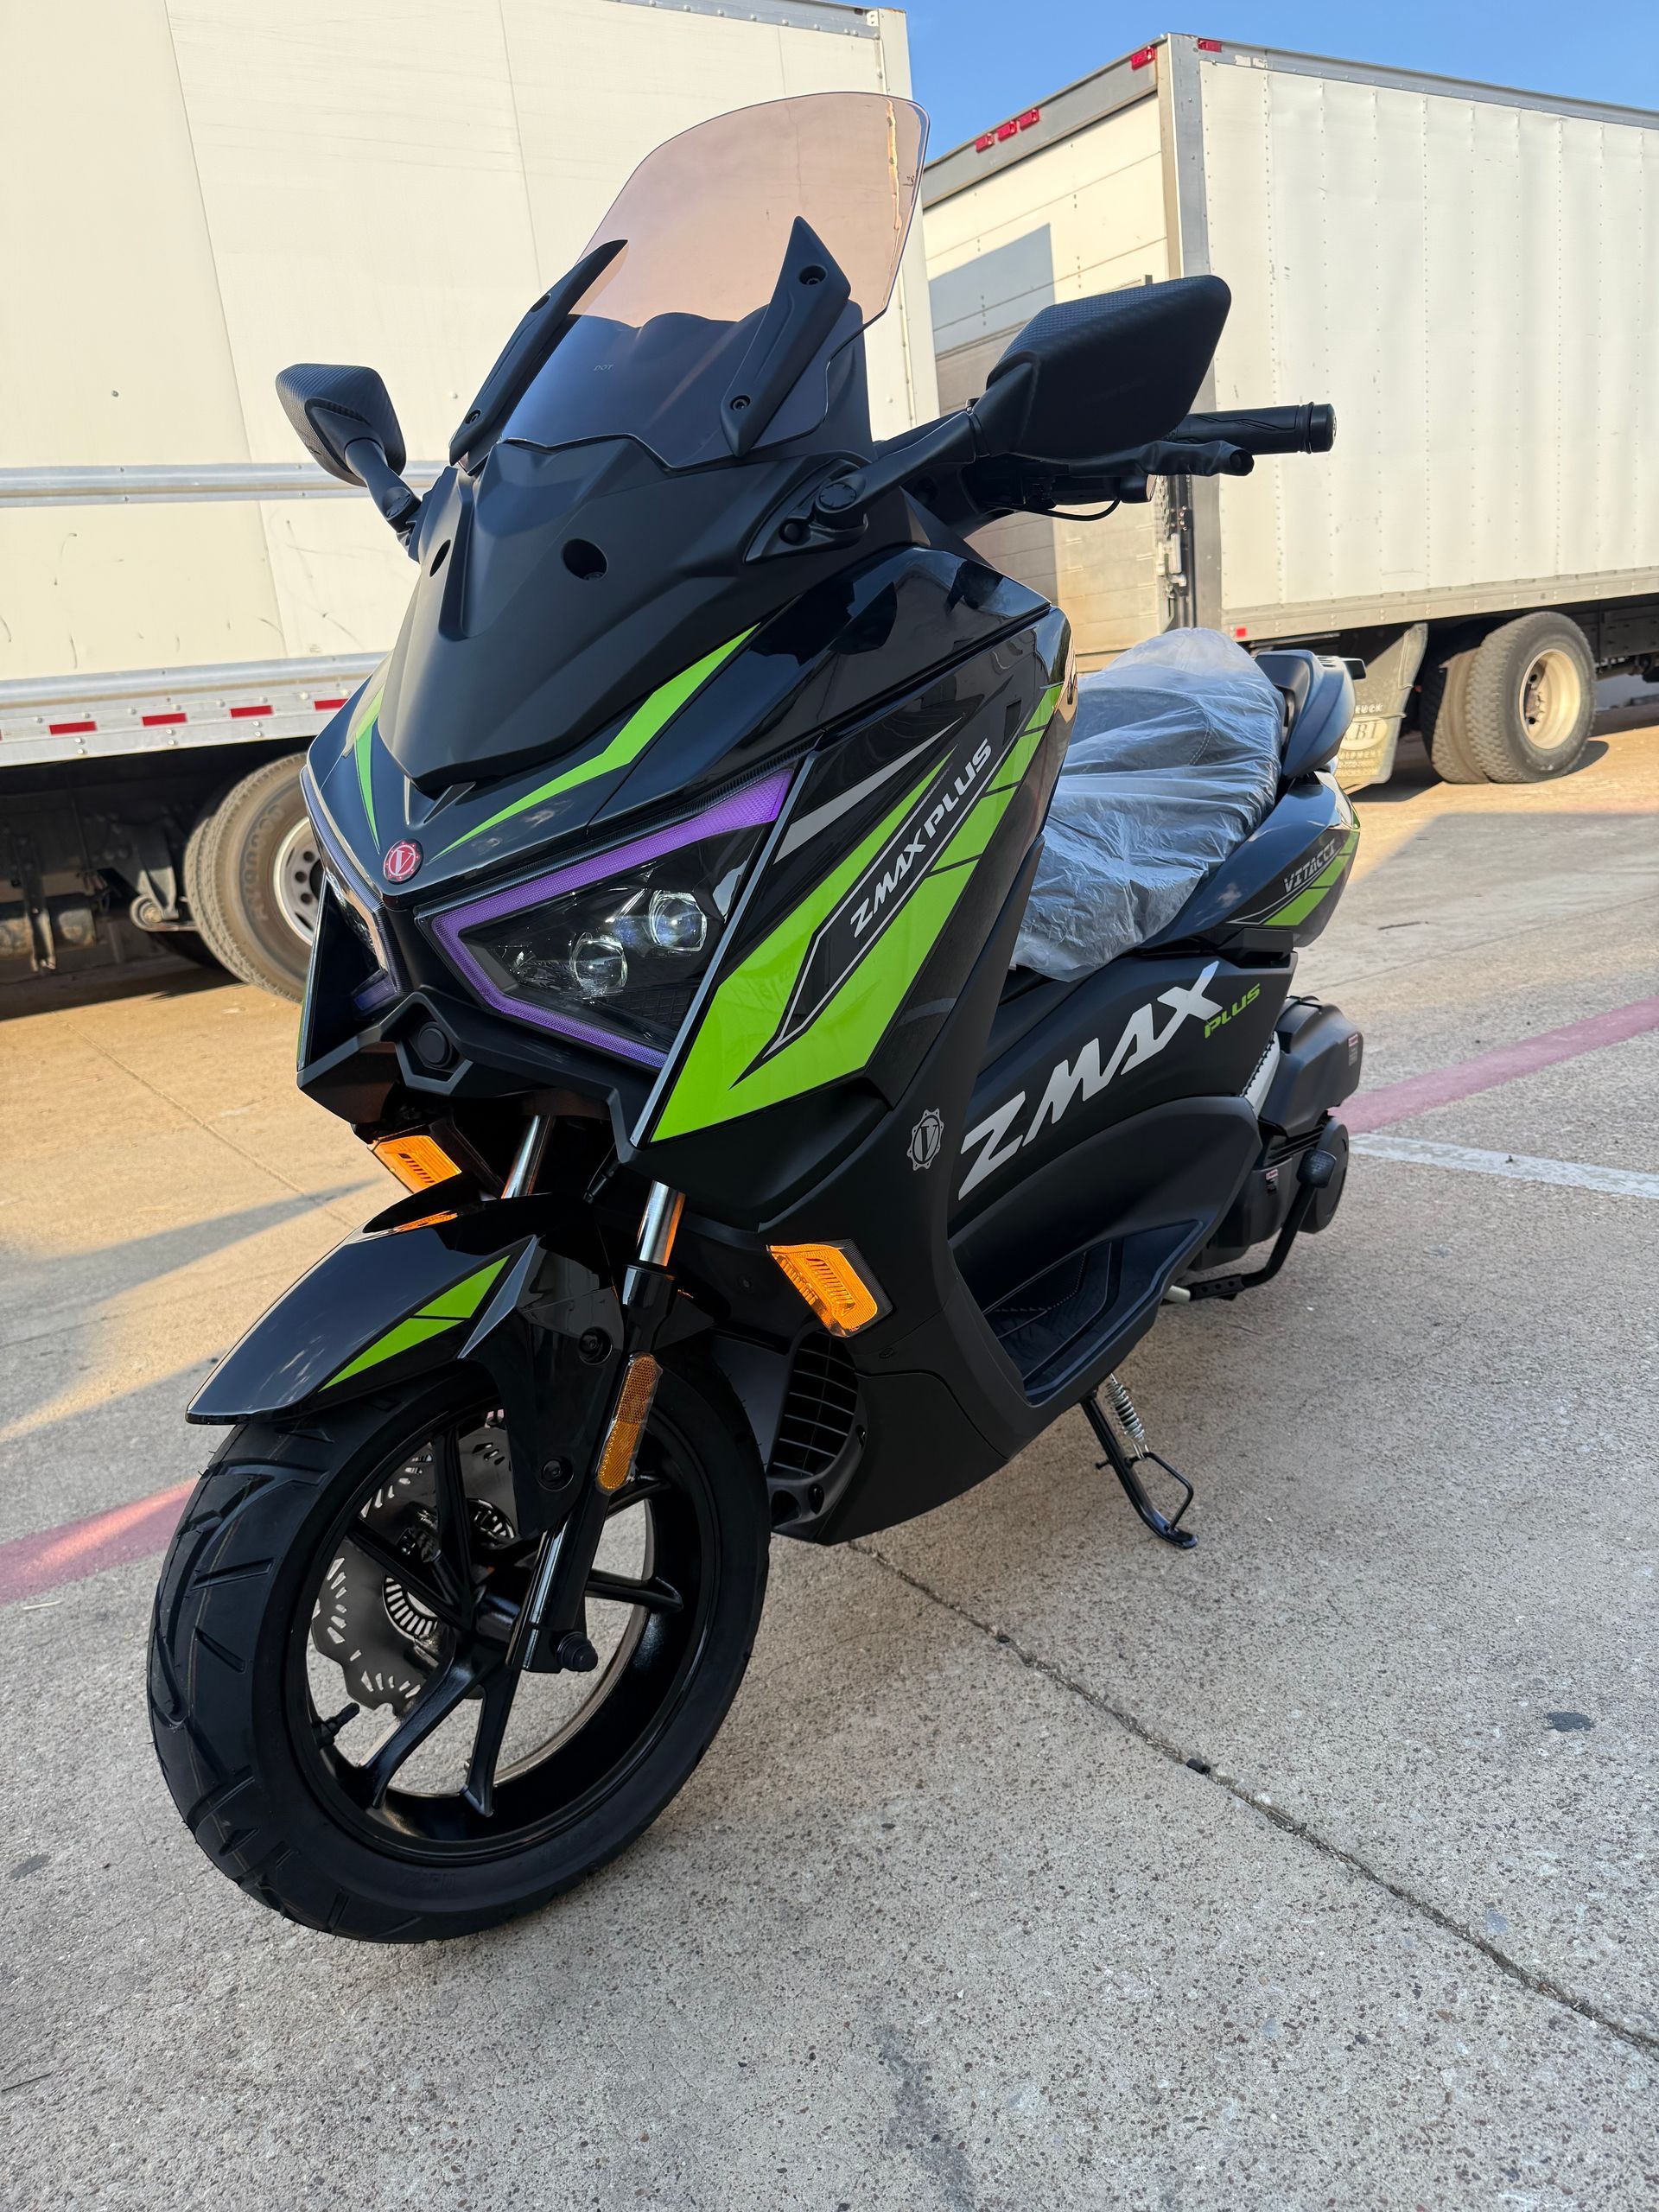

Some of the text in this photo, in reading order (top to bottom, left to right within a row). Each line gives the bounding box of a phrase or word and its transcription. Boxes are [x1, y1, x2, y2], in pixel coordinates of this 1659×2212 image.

[1355, 703, 1382, 714] RUCK
[850, 738, 992, 938] ZMAX PLUS
[1283, 838, 1335, 893] VITACCI
[958, 960, 1260, 1200] ZMAX PLUS
